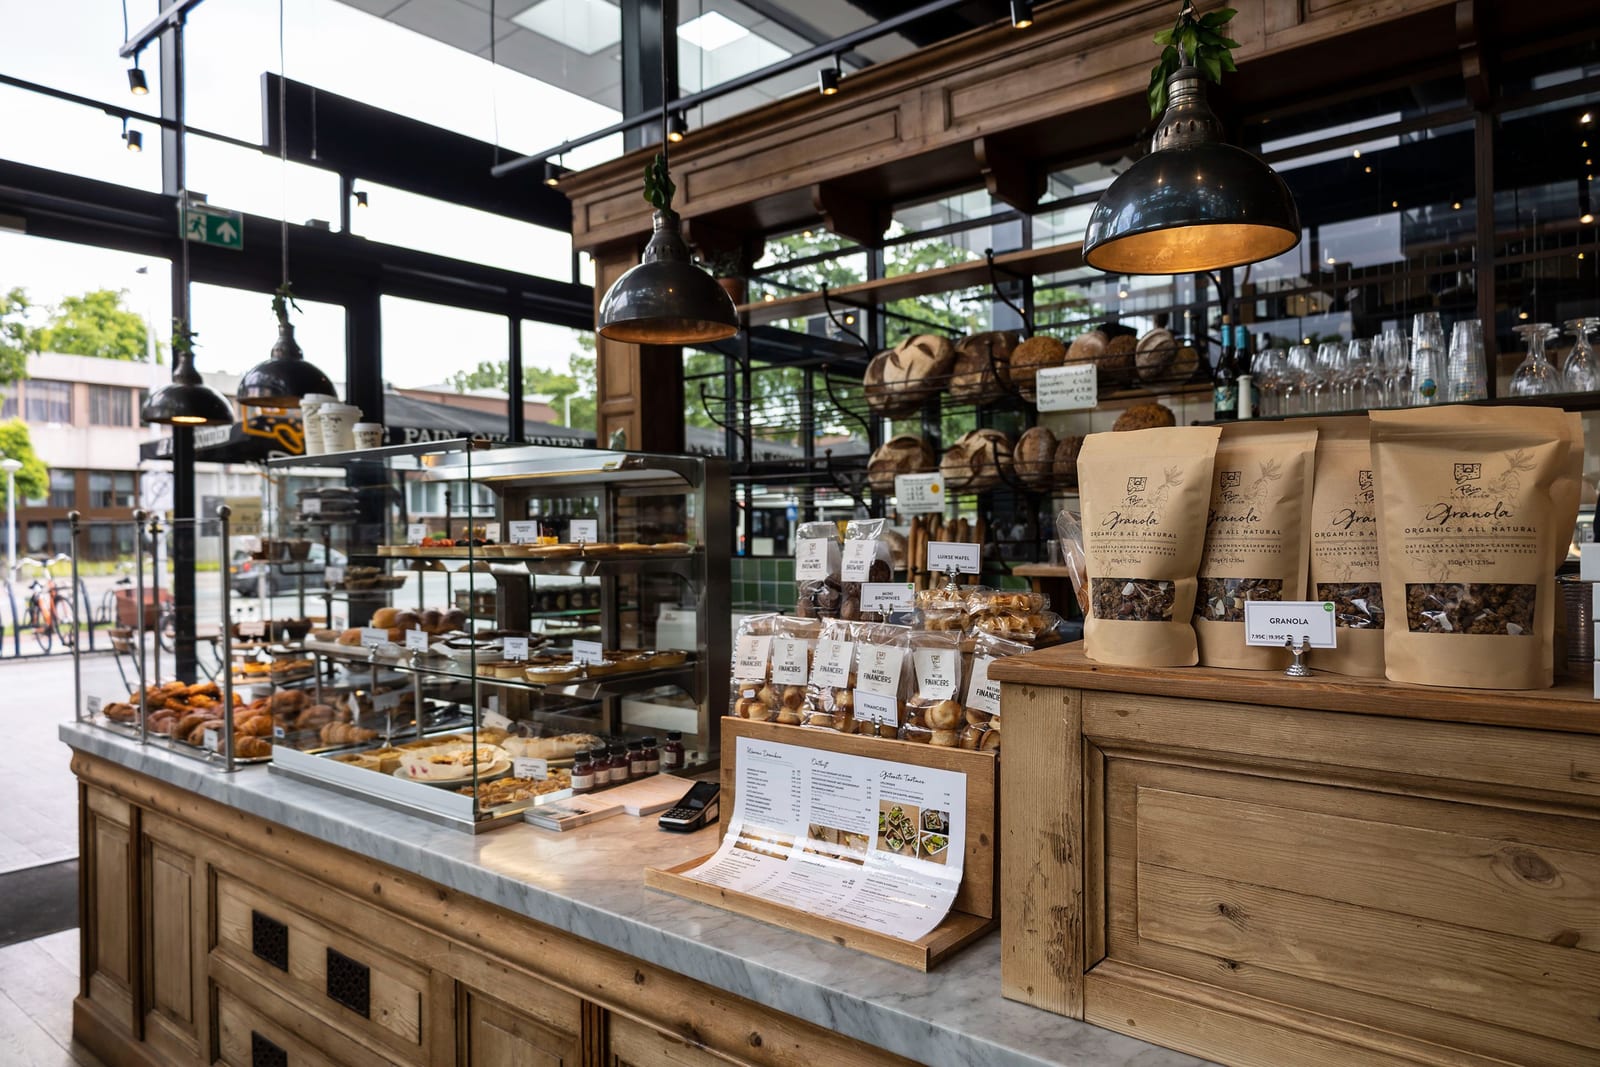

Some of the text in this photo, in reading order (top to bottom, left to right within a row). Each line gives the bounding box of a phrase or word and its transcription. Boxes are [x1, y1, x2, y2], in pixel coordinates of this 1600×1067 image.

[1425, 501, 1513, 526] Granola
[1102, 510, 1160, 530] Granola
[1142, 531, 1177, 539] NATURAL
[1269, 617, 1309, 625] GRANOLA
[778, 665, 801, 673] FINANCIERS
[820, 666, 843, 675] FINANCIERS
[863, 673, 892, 684] FINANCIERS
[924, 678, 950, 687] FINANCIERS
[863, 703, 888, 712] FINANCIERS
